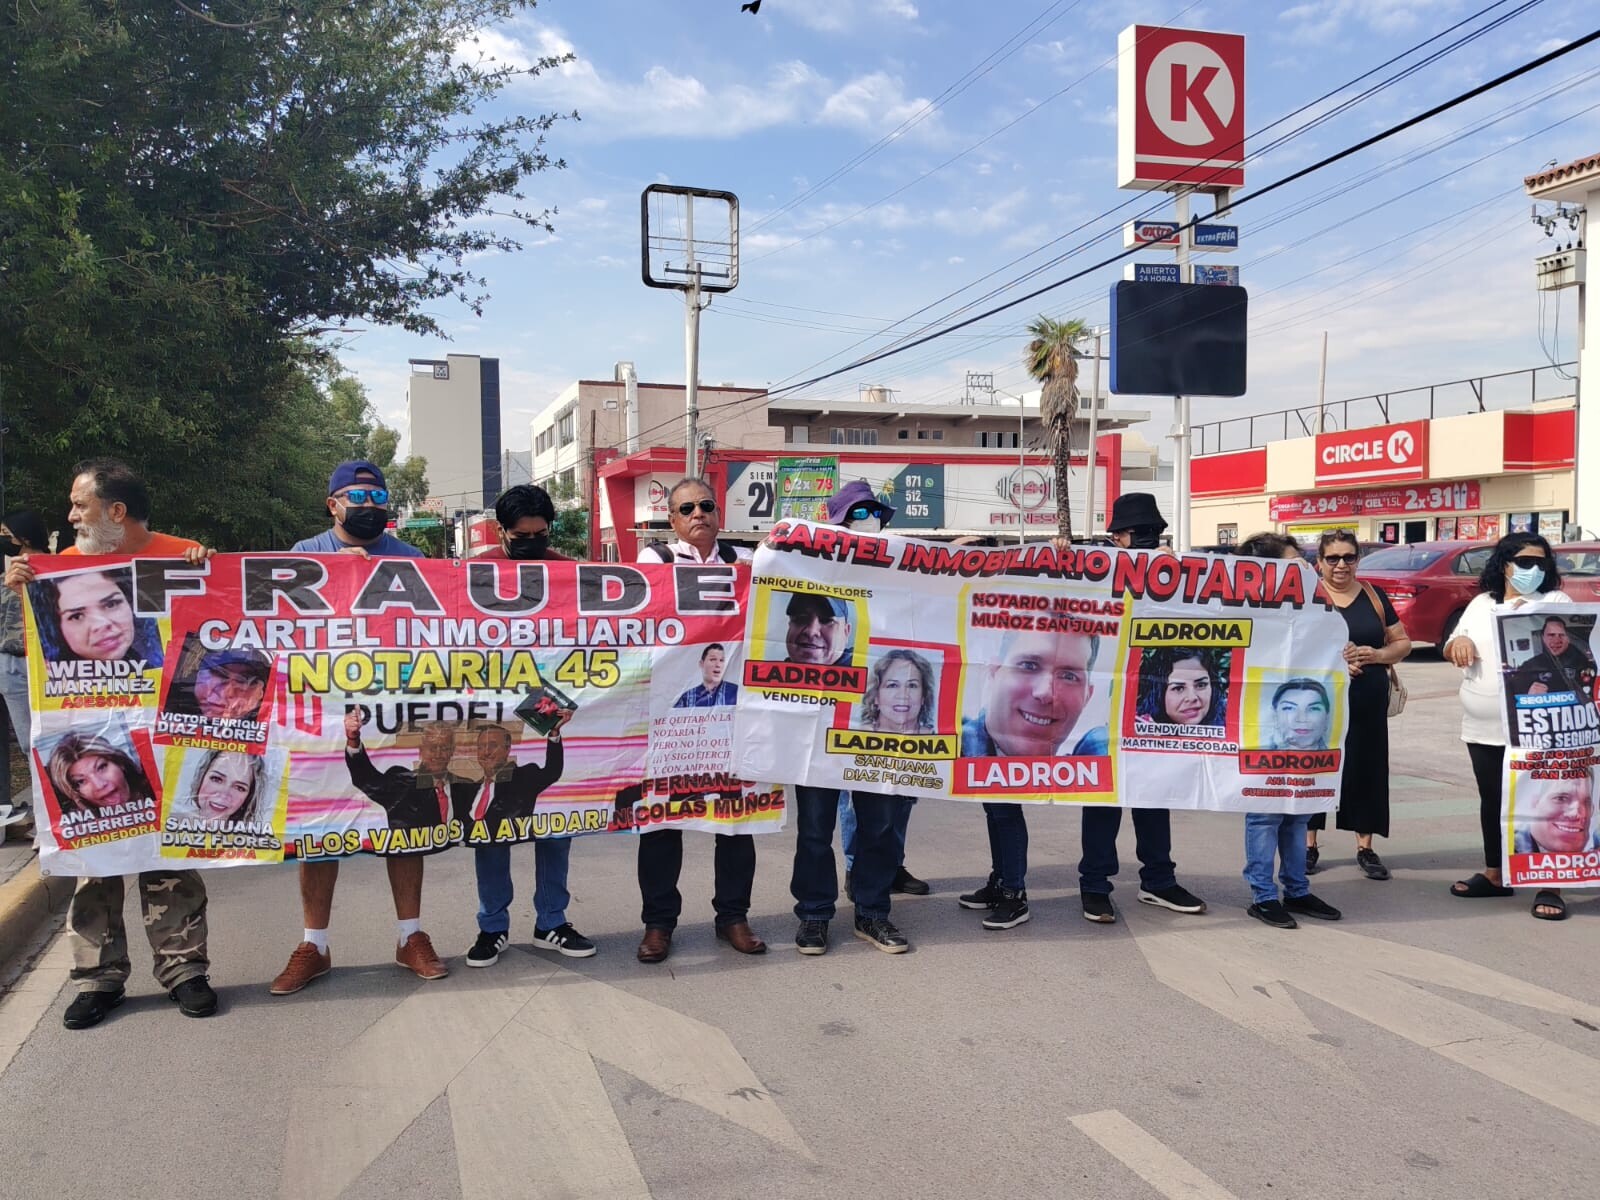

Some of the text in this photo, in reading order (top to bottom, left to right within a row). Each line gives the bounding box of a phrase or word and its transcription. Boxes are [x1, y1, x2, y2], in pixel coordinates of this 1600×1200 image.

[1170, 62, 1226, 141] K
[1140, 266, 1176, 275] ABIERTO
[1322, 440, 1383, 465] CIRCLE
[750, 472, 777, 480] SIEM
[905, 475, 921, 487] 871
[905, 490, 921, 502] 512
[905, 504, 929, 516] 4575
[769, 521, 896, 569] CARTEL
[897, 543, 1111, 582] INMOBILIARIO
[1112, 550, 1305, 610] NOTARIA
[131, 555, 742, 617] FRAUDE
[752, 575, 804, 590] ENRIQUE
[833, 587, 873, 599] FLORES
[971, 593, 1125, 617] NOTARIO NICOLAS
[970, 610, 1119, 636] MUÑOZ SAN JUAN
[1135, 622, 1243, 642] LADRONA
[199, 617, 686, 651] CARTEL INMOBILIARIO
[49, 659, 148, 679] WENDY
[288, 648, 621, 694] NOTARIA 45
[751, 664, 859, 689] LADRON
[44, 677, 156, 698] MARTINEZ
[61, 695, 143, 709] ASESORA
[762, 690, 838, 707] VENDEDOR
[1519, 693, 1576, 705] SEGUNDO
[160, 711, 268, 731] VICTOR ENRIQUE
[653, 718, 666, 726] ME
[720, 713, 732, 722] LA
[157, 720, 267, 743] DIAZ FLORES
[653, 726, 695, 739] NOTARIA
[1135, 723, 1225, 737] WENDY LIZETTE
[172, 737, 247, 753] VENDEDOR
[653, 740, 678, 751] PERO
[680, 739, 694, 749] NO
[710, 737, 730, 748] QUE
[832, 733, 950, 755] LADRONA
[1122, 738, 1238, 753] MARTINEZ ESCOBAR
[1518, 731, 1553, 749] MÁS
[671, 752, 695, 761] SIGO
[854, 754, 938, 775] SANJUANA
[1244, 754, 1335, 770] LADRONA
[1510, 760, 1568, 771] NICOLAS
[1525, 751, 1543, 761] EX
[653, 763, 724, 775] Y CON AMPARO
[843, 767, 944, 790] DIAZ FLORES
[967, 760, 1099, 788] LADRON
[1530, 769, 1590, 780] SAN JUA
[1265, 776, 1285, 786] ANA
[59, 797, 156, 828] ANA MARIA
[713, 788, 786, 820] MUÑOZ
[61, 810, 157, 841] GUERRERO
[165, 817, 275, 837] SANJUANA
[294, 809, 609, 861] ¡LOS VAMOS A AYUDAR!
[70, 824, 157, 850] VENDEDORA
[161, 831, 282, 850] DIAZ FLORES
[186, 848, 257, 860] ASESORA
[1528, 852, 1600, 870] LADRO
[1516, 870, 1554, 883] (LIDER
[1557, 869, 1580, 880] DEL
